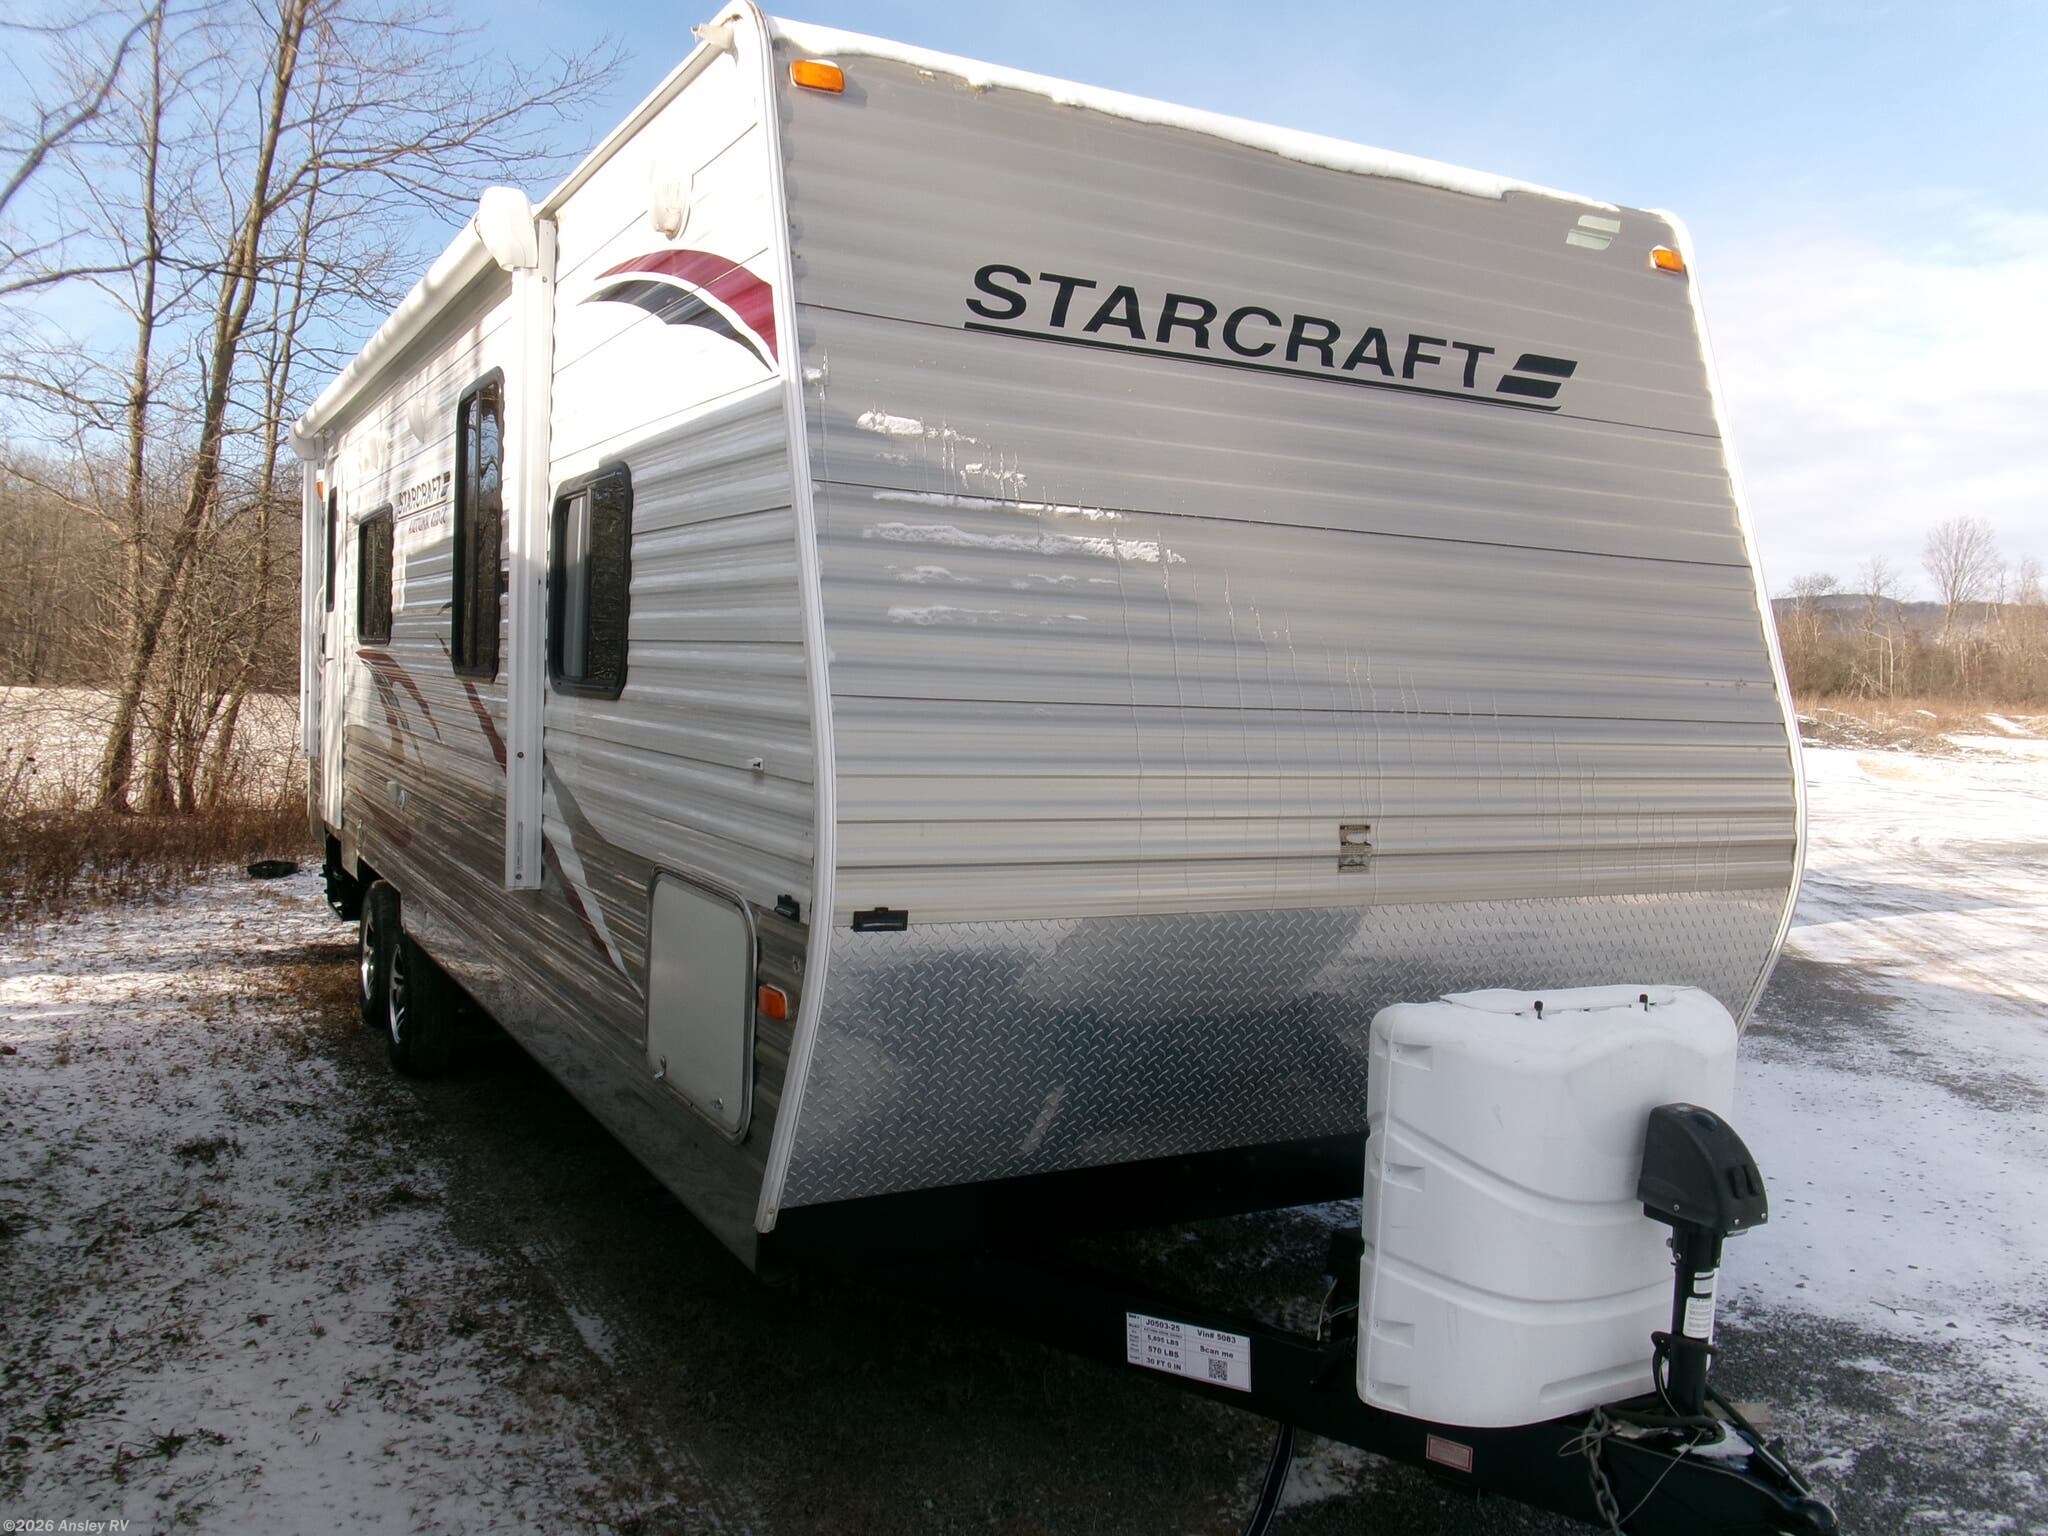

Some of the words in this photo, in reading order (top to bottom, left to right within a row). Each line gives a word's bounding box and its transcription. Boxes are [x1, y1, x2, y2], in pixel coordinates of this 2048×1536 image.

[965, 263, 1495, 389] STARCRAFT
[398, 475, 441, 514] STARCRAFT
[1146, 1319, 1180, 1332] J0503-25
[1148, 1345, 1162, 1354] 570
[1164, 1349, 1179, 1358] LBS
[1200, 1345, 1219, 1355] Scan
[1222, 1351, 1234, 1359] me
[1173, 1363, 1181, 1371] IN
